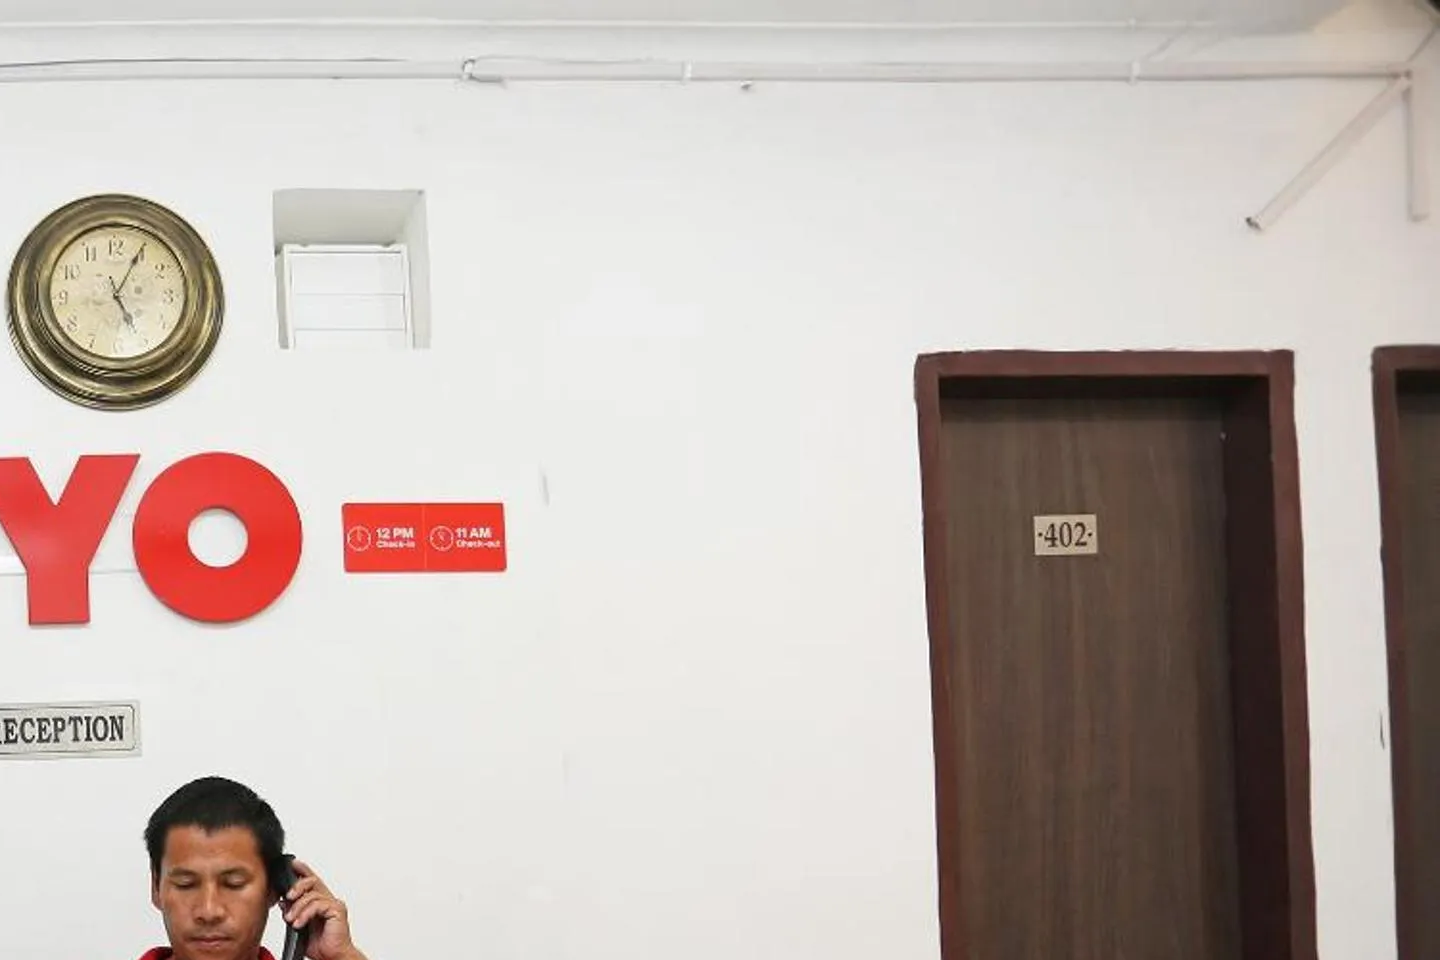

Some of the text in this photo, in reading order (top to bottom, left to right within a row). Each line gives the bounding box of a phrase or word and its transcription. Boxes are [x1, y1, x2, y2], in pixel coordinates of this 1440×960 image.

[85, 246, 97, 262] 11
[108, 239, 124, 256] 12
[64, 264, 80, 280] 10
[155, 263, 165, 279] 2
[58, 290, 68, 305] 9
[163, 289, 174, 304] 3
[375, 527, 414, 538] 12 PM
[455, 527, 492, 538] 11 AM
[1044, 521, 1088, 548] 402
